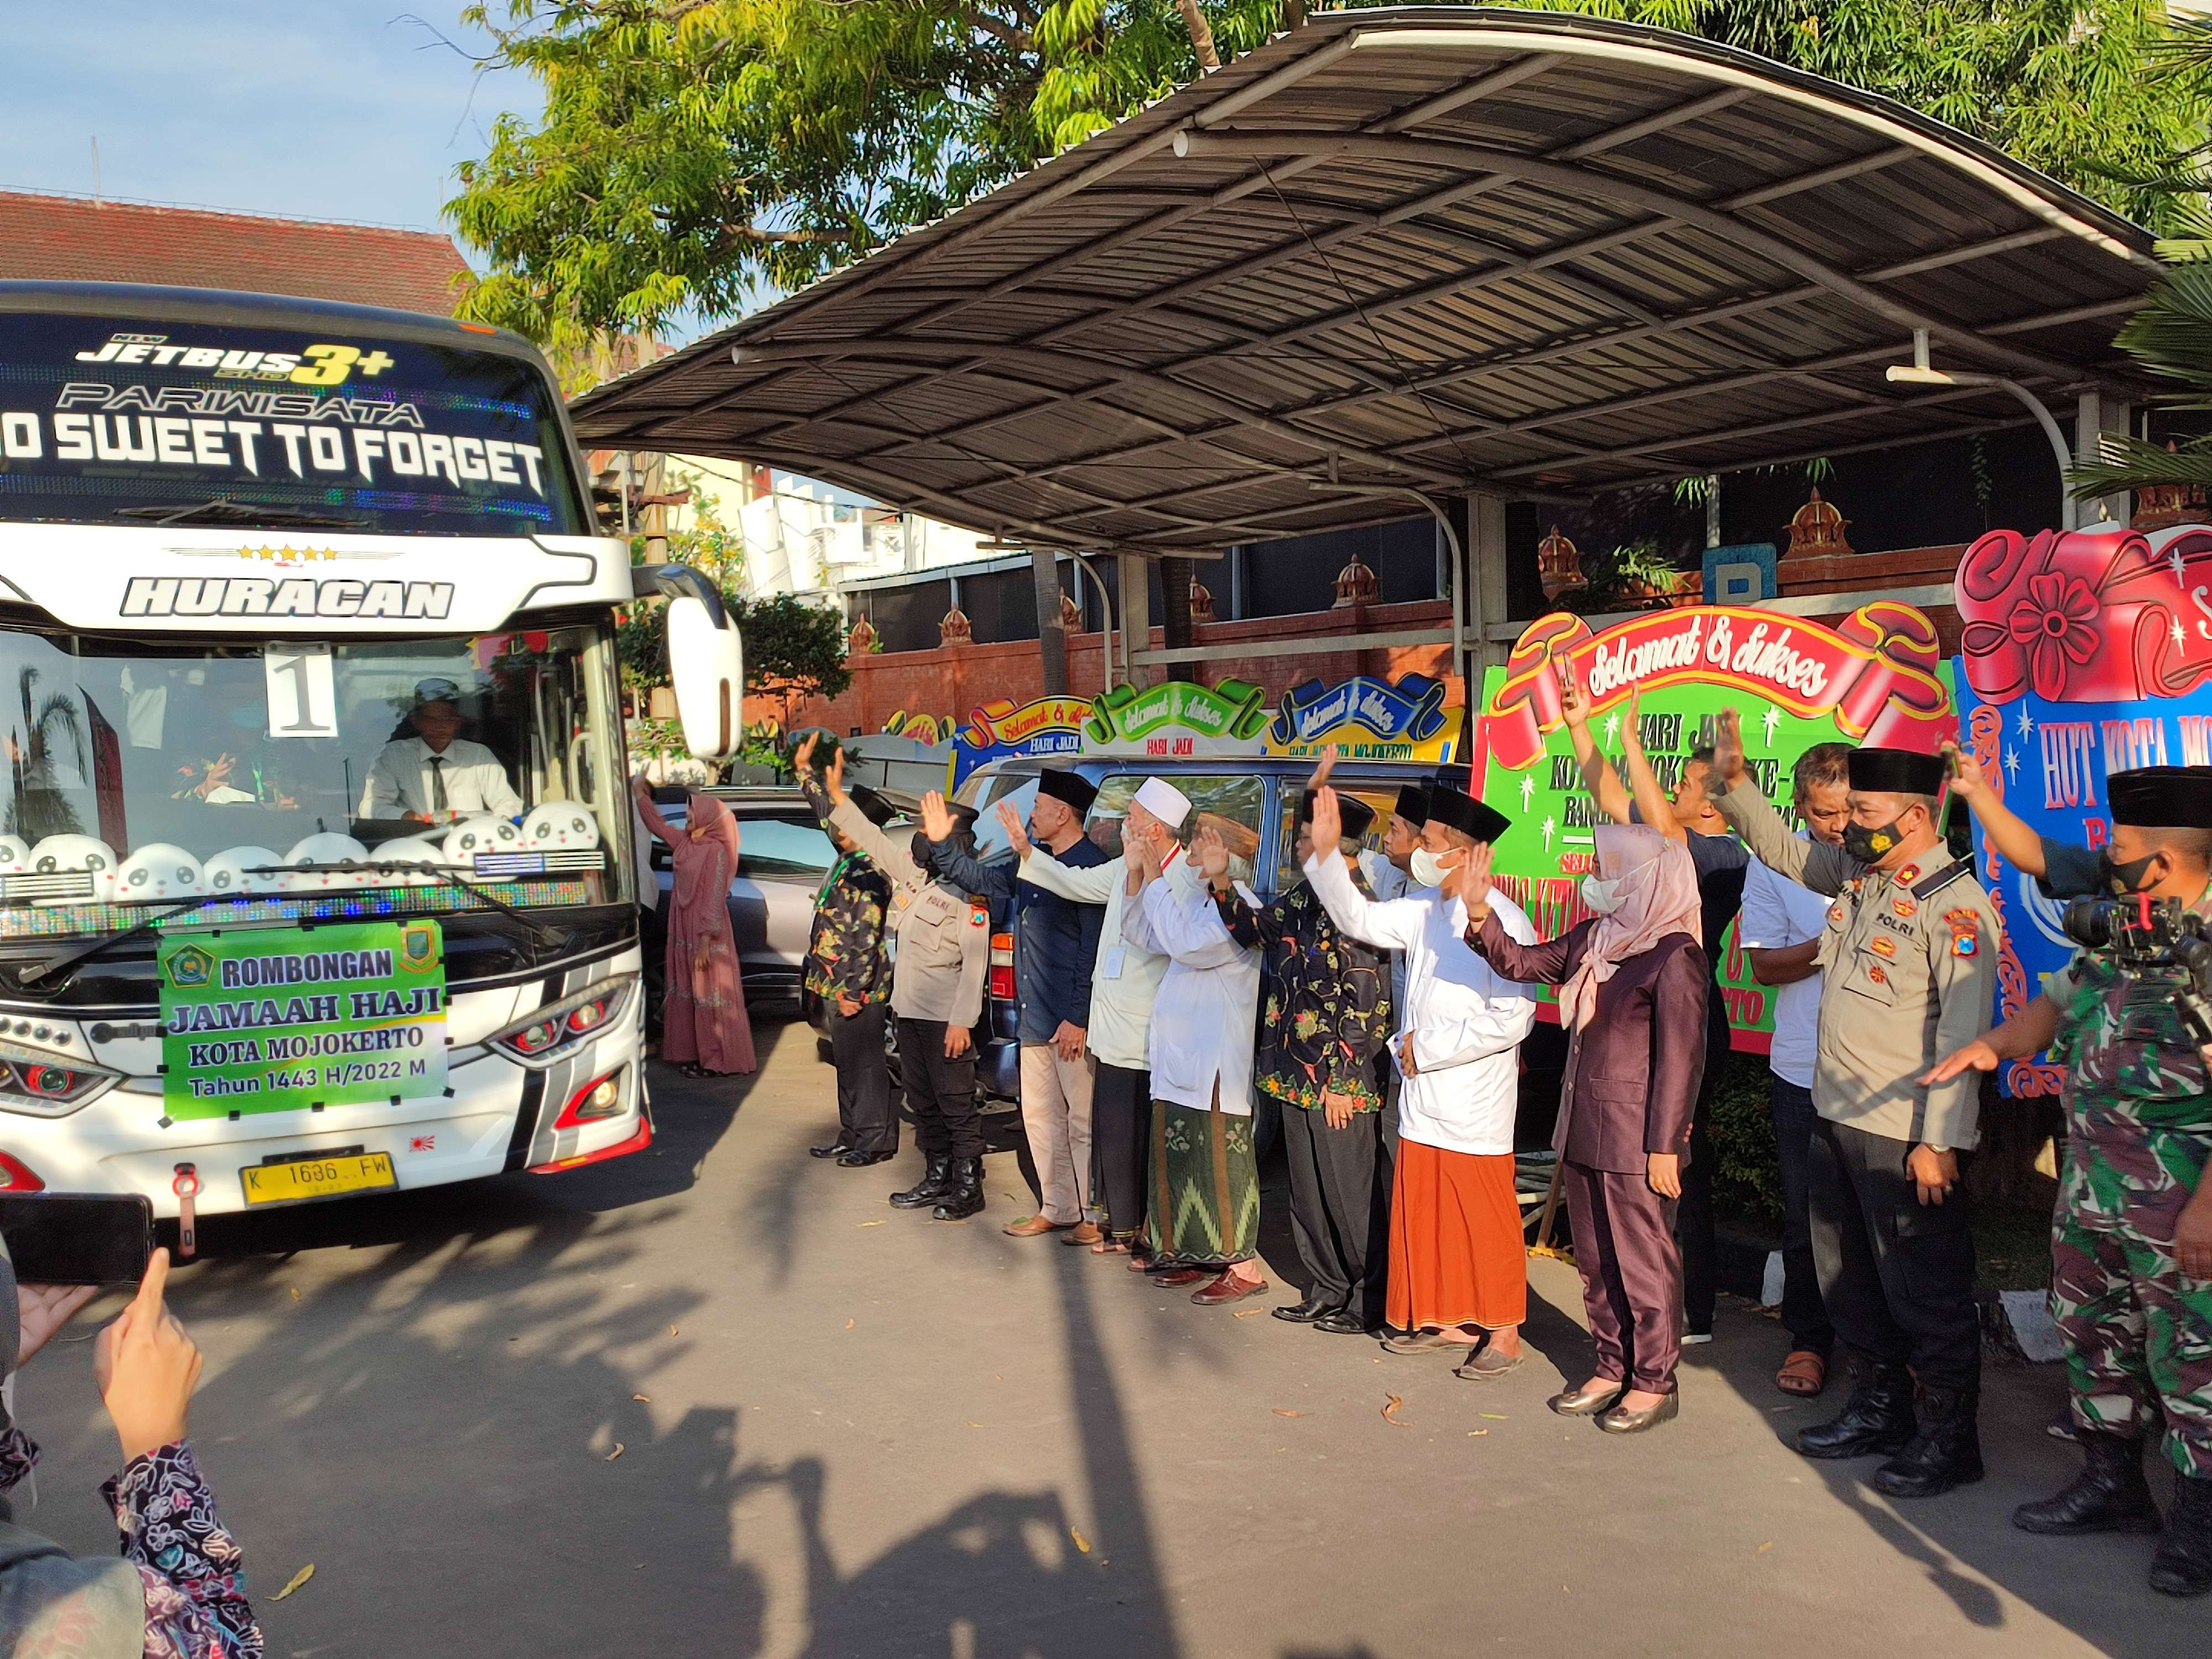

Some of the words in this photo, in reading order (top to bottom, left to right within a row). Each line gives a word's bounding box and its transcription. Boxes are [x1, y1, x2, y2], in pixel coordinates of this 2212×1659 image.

[75, 342, 302, 372] JETBUS
[55, 383, 425, 427] PARIWISATA
[54, 413, 263, 477] SWEET
[273, 423, 346, 479] TO
[353, 428, 543, 497] FORGET
[119, 577, 455, 619] HURACAN
[1589, 615, 1702, 697] Selamat
[1706, 615, 1733, 670] &
[1731, 622, 1828, 698] Sukses
[273, 655, 331, 731] 1
[1125, 693, 1168, 733] Selamat
[1185, 695, 1222, 727] Sukses
[1301, 689, 1346, 737] Selamat
[1004, 706, 1049, 740] Selamat
[1030, 738, 1053, 753] HARI
[1056, 736, 1079, 751] JADI
[1146, 738, 1168, 755] HARI
[1172, 738, 1193, 755] JADI
[2038, 722, 2096, 809] HUT
[926, 895, 951, 911] POLRI
[1876, 912, 1915, 937] POLRI
[222, 950, 392, 987] ROMBONGAN
[168, 996, 340, 1034] JAMAAH
[350, 988, 441, 1020] HAJI
[189, 1041, 261, 1067] KOTA
[267, 1027, 424, 1061] MOJOKERTO
[189, 1077, 259, 1097] Tahun
[267, 1068, 317, 1089] 1443
[326, 1061, 401, 1086] H/2022
[409, 1059, 426, 1077] M
[248, 1171, 261, 1190] K
[359, 1156, 387, 1177] FW
